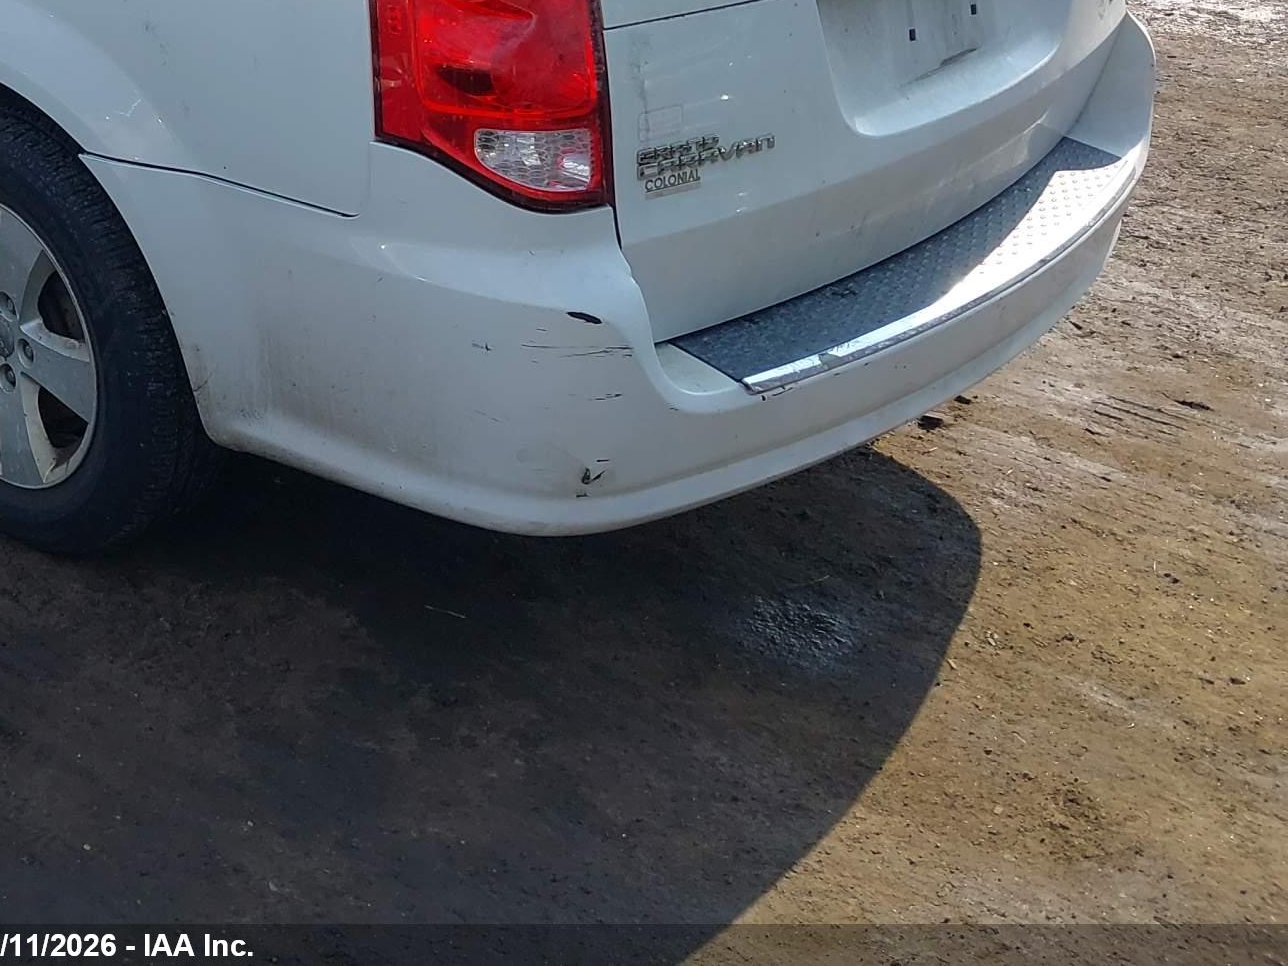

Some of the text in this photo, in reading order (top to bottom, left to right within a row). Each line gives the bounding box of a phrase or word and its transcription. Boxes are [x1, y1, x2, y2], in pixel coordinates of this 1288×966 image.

[636, 133, 720, 166] GRAND
[636, 133, 776, 181] CARAVAN
[644, 168, 702, 193] COLONIAL
